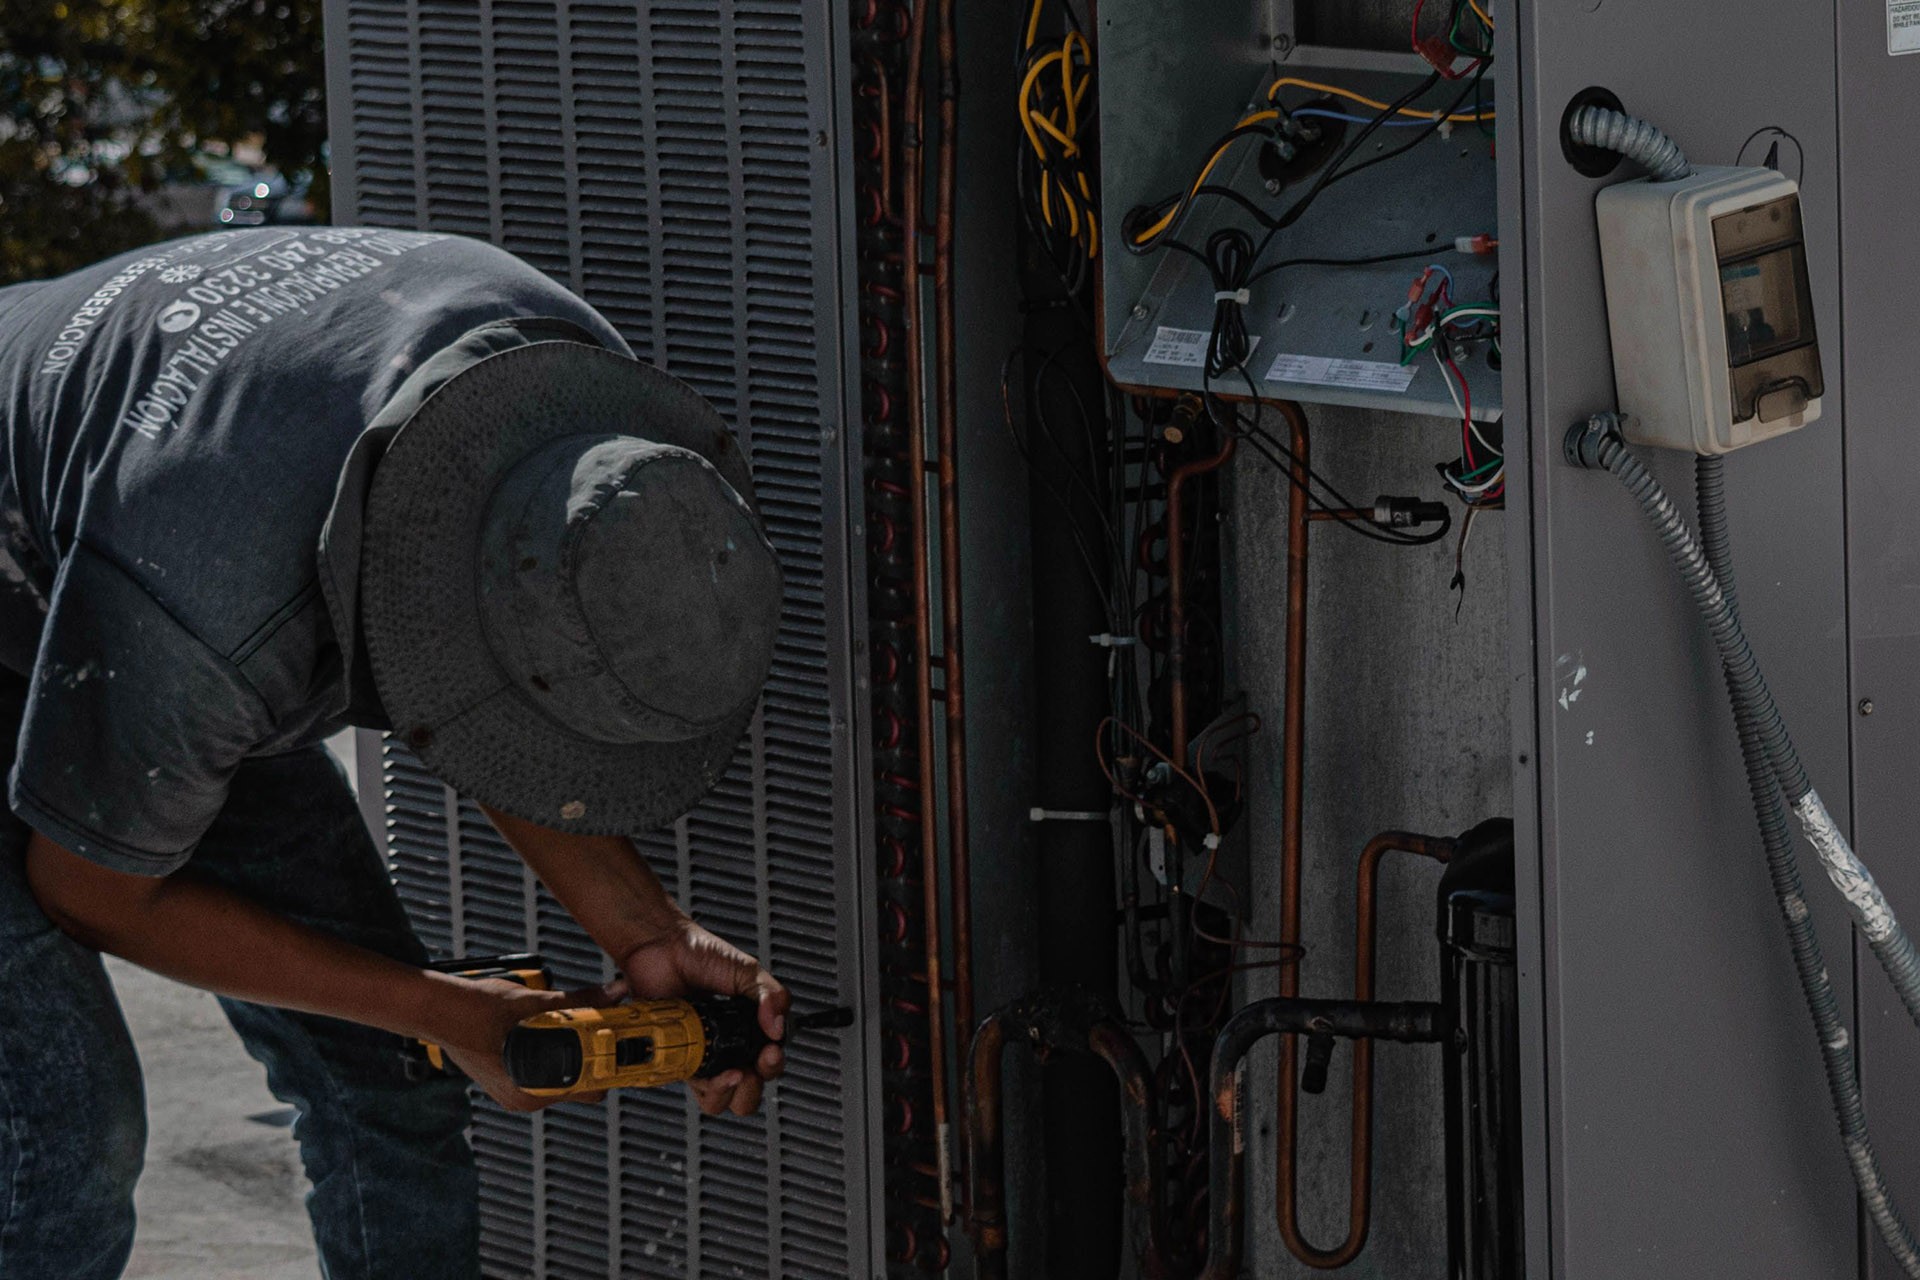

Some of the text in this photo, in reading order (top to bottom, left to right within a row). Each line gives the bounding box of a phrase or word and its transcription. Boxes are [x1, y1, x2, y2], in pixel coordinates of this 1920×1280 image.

[258, 241, 326, 271] 240
[187, 265, 272, 305] 3230
[123, 247, 383, 440] REPARACIÓN E INSTALACIÓN
